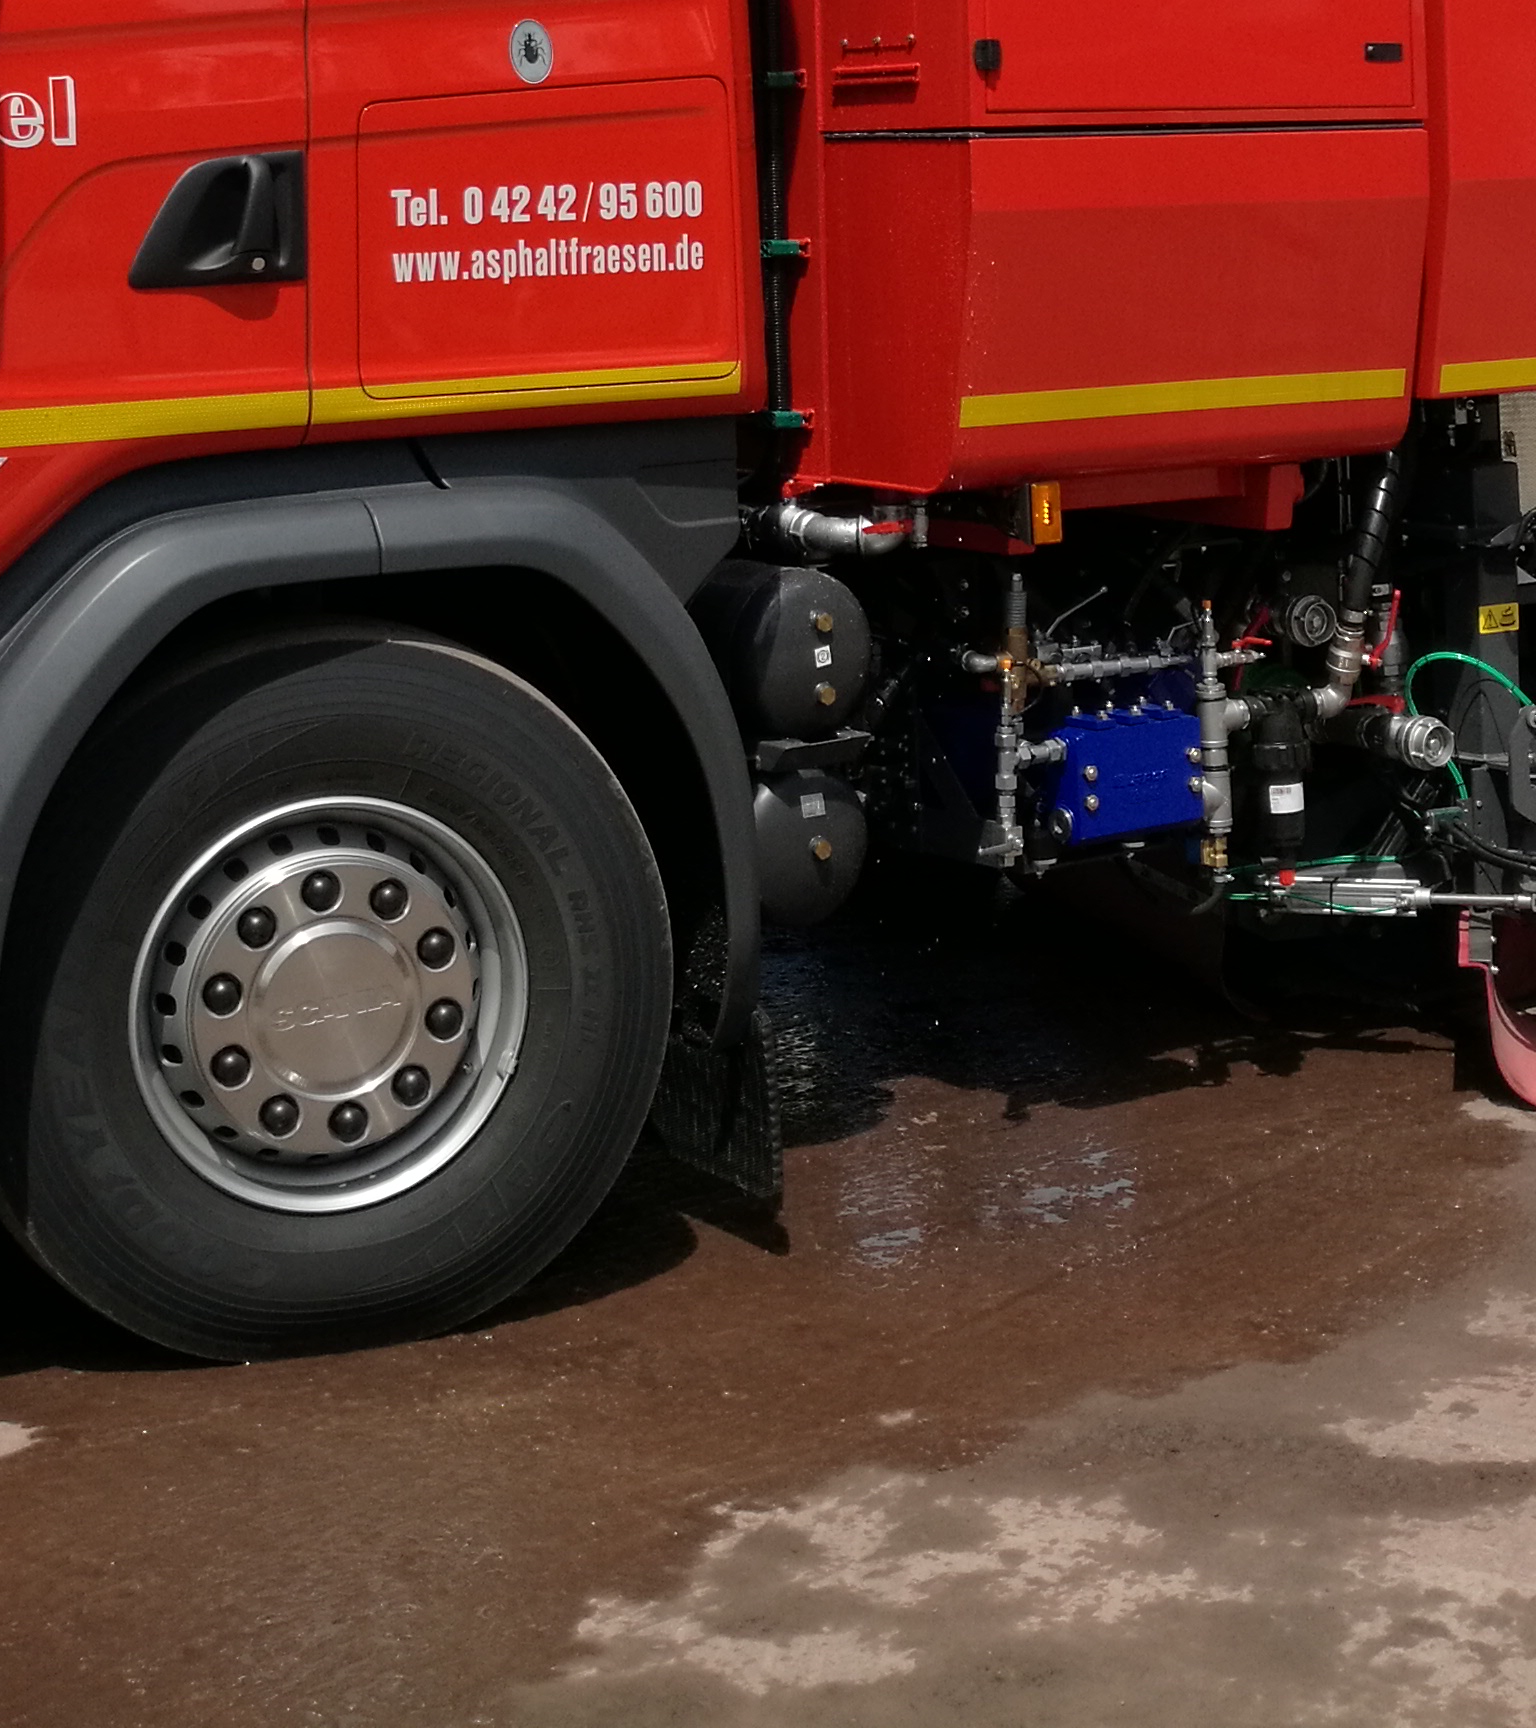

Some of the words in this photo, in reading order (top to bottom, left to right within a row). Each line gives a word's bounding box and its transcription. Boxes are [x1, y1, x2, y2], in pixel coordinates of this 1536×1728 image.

[390, 188, 448, 227] Tel.
[645, 180, 703, 219] 600
[392, 234, 704, 284] www.asphaltfraesen.de
[403, 723, 577, 879] REGIONAL
[271, 985, 403, 1032] SCANIA
[39, 994, 278, 1301] GOODYEA
